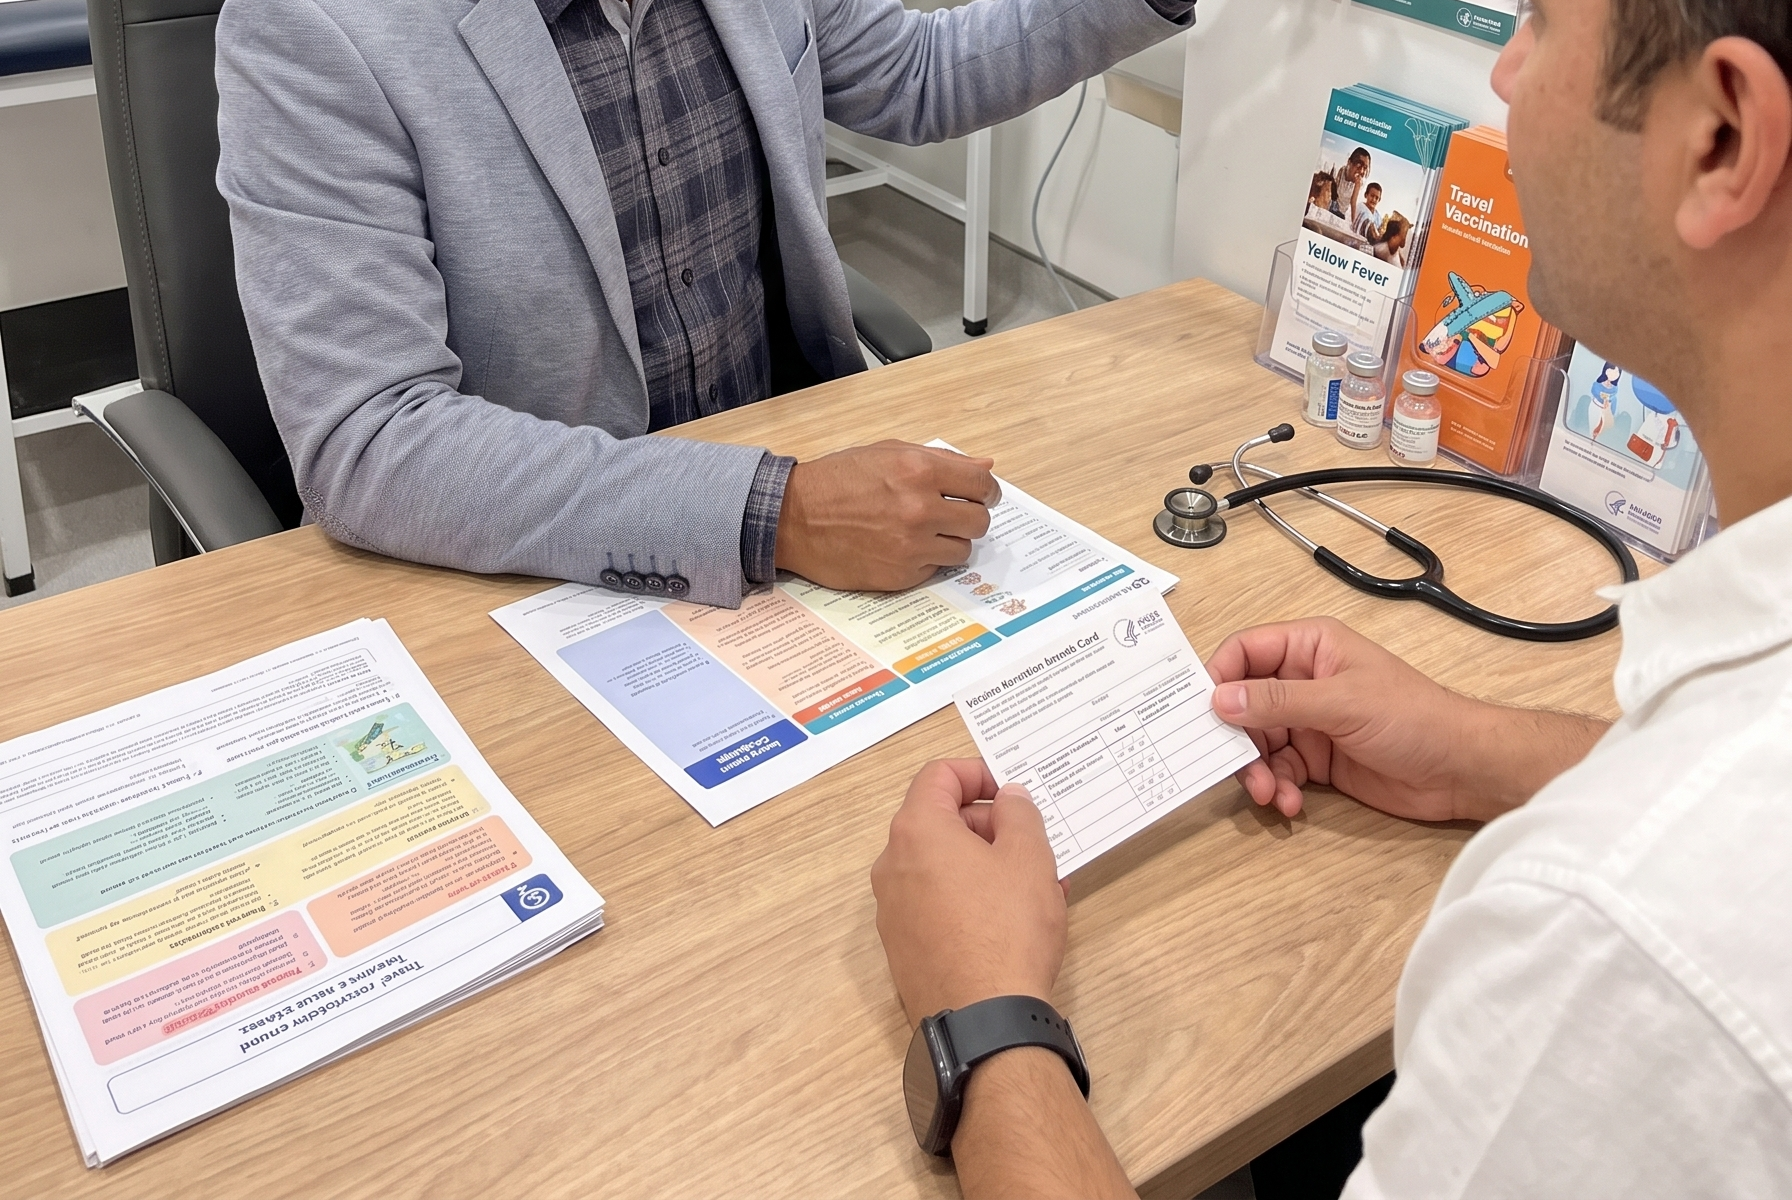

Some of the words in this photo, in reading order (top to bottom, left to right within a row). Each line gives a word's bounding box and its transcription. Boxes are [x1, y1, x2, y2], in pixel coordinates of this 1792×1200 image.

[1449, 184, 1495, 215] Travel
[1444, 202, 1529, 249] Vaccination
[1308, 240, 1349, 270] Yellow
[1351, 260, 1389, 287] Fever
